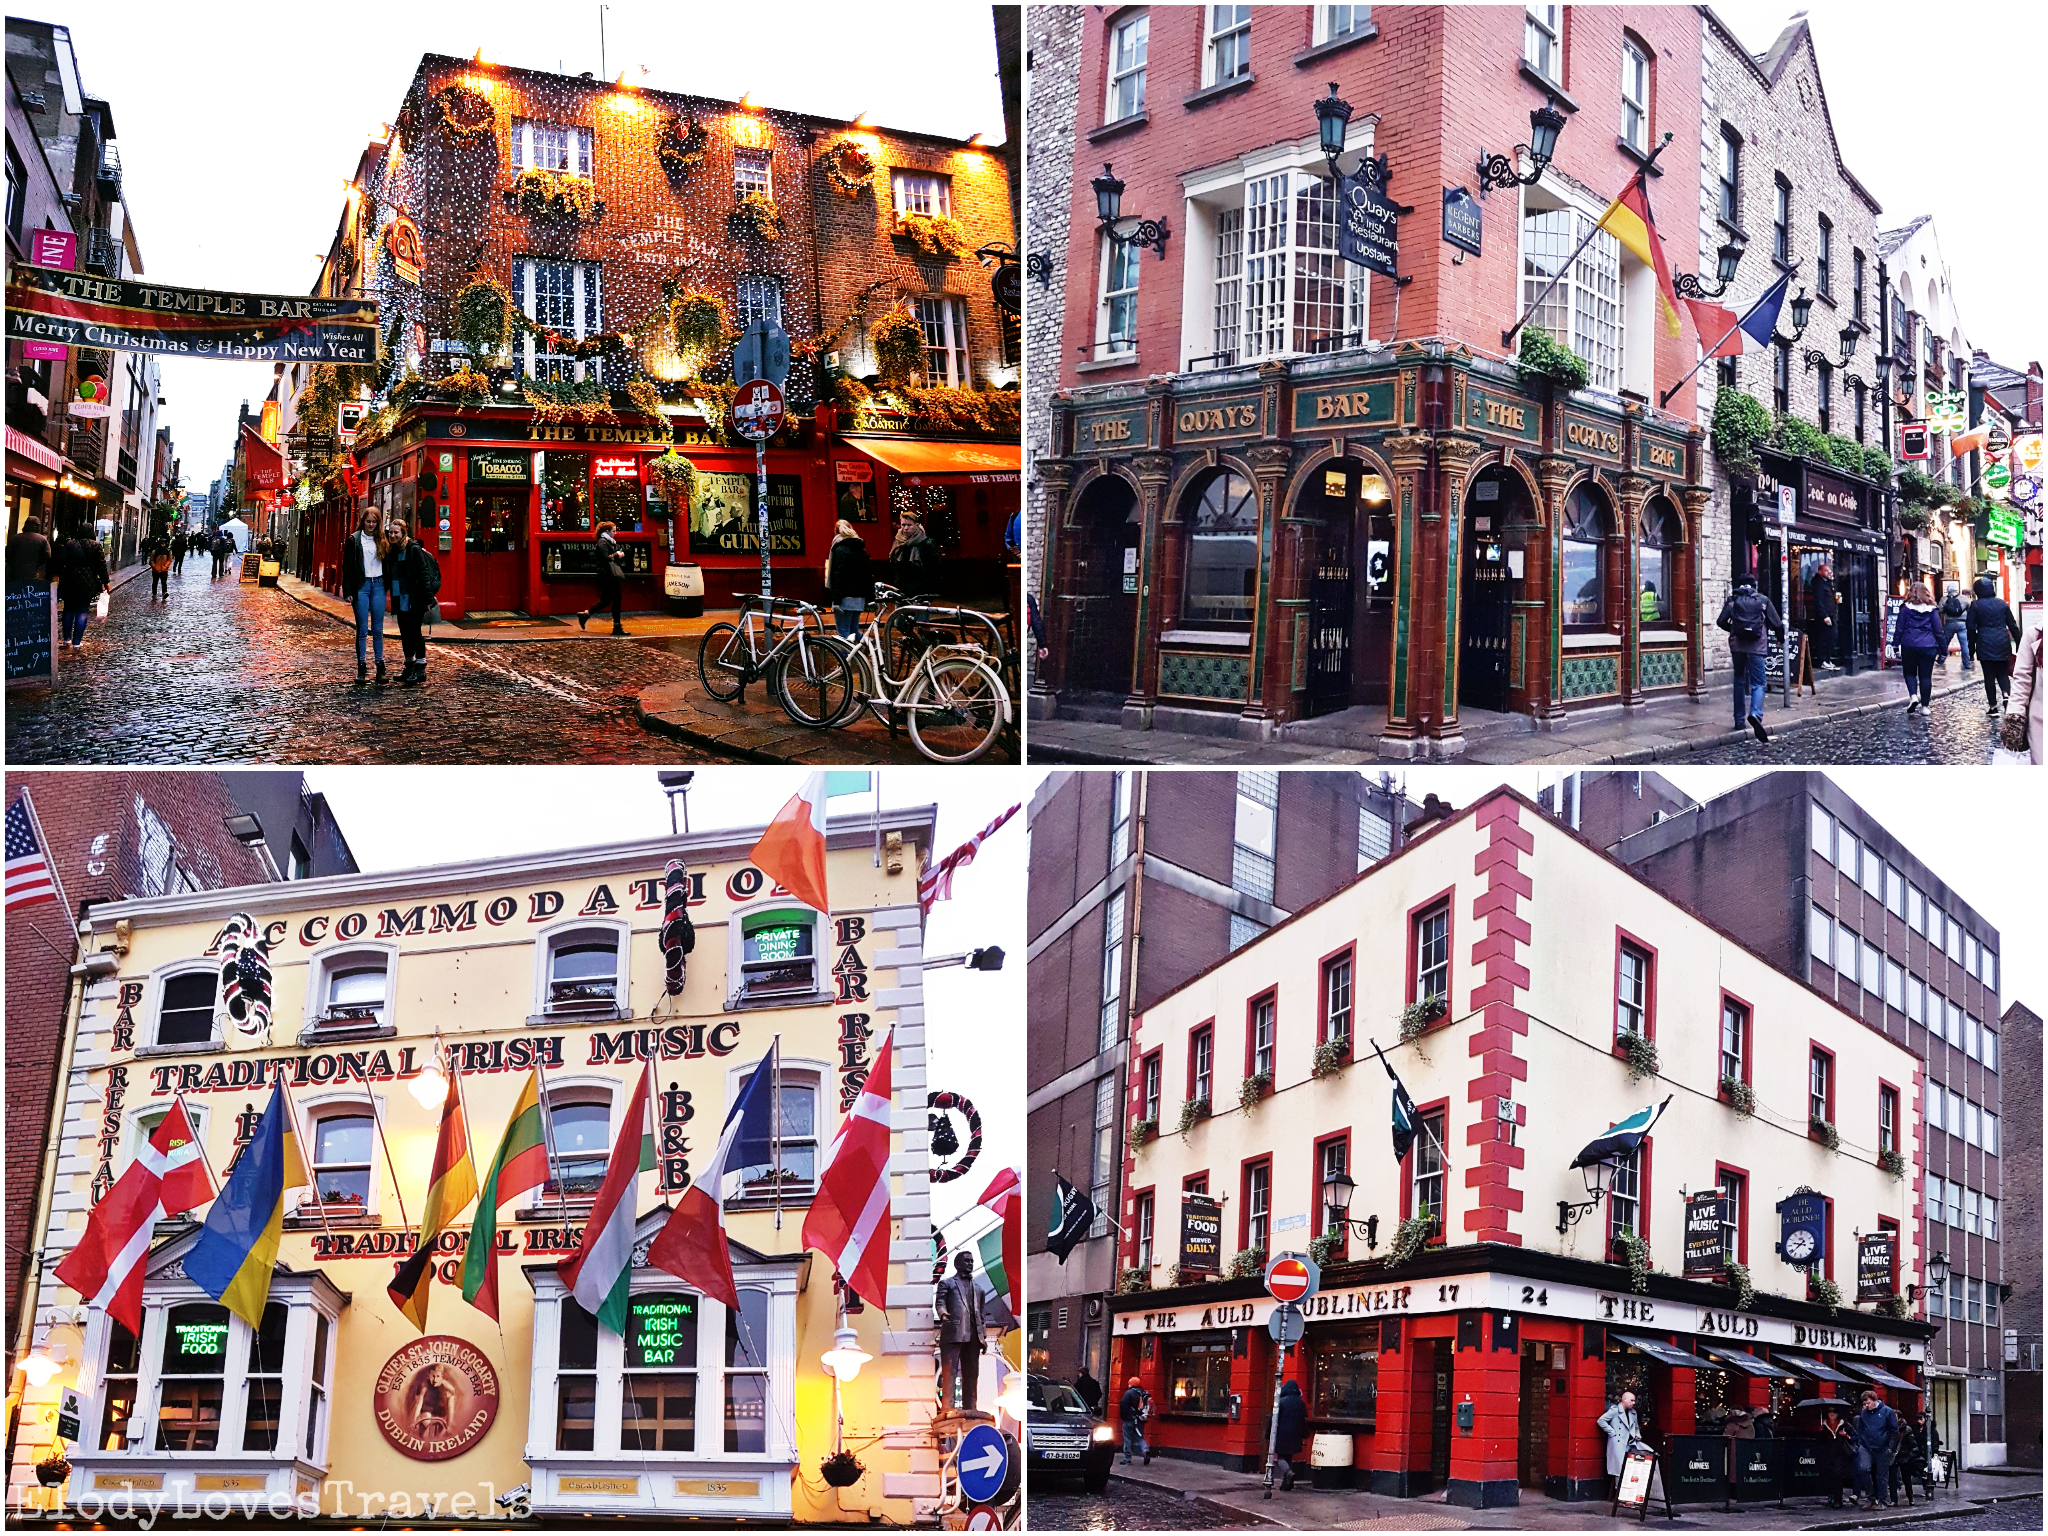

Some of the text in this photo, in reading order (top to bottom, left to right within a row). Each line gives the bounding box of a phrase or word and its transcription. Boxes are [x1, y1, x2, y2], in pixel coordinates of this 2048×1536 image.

[1447, 205, 1481, 229] REGENT
[1366, 218, 1386, 235] Irish
[1448, 219, 1480, 241] BARBERS
[1351, 222, 1399, 253] Restaurant
[1356, 240, 1392, 266] Upstairs
[63, 276, 312, 319] THE TEMPLE BAR
[12, 313, 366, 360] Merry Christmas & Happy New Year
[322, 332, 364, 342] Wishes All
[1316, 392, 1371, 420] BAR
[1485, 399, 1526, 432] THE
[451, 425, 463, 434] 48
[1091, 419, 1132, 443] THE
[526, 426, 731, 447] THE TEMPLE BAR
[1649, 444, 1677, 469] BAR
[252, 471, 281, 480] TEMPLE
[478, 461, 523, 477] TOBACCO
[708, 477, 748, 486] TEMPLE
[970, 475, 990, 483] THE
[721, 485, 740, 494] BAR
[777, 485, 794, 496] THE
[785, 507, 795, 518] OF
[720, 533, 801, 550] GUINESS
[754, 930, 801, 943] PRIVATE
[758, 940, 797, 952] DINING
[760, 950, 795, 961] ROOM
[150, 1021, 742, 1097] TRADITIONAL IRISH MUSIC
[1185, 1213, 1220, 1222] TRADITIONAL
[1693, 1205, 1716, 1221] LIVE
[1187, 1219, 1218, 1234] FOOD
[1688, 1219, 1720, 1232] MUSIC
[1186, 1243, 1216, 1253] DAILY
[1688, 1238, 1718, 1249] EVERY DAY
[1686, 1245, 1721, 1259] TILL LATE
[1864, 1244, 1887, 1257] LIVE
[1861, 1255, 1890, 1265] MUSIC
[1859, 1276, 1891, 1287] TILL LATE
[632, 1304, 693, 1316] TRADITIONAL
[1122, 1284, 1461, 1330] 7 THE AULD UBLINER 17
[644, 1317, 678, 1331] IRISH
[1521, 1285, 1549, 1307] 24
[1598, 1294, 1656, 1323] THE
[1699, 1309, 1760, 1339] AULD
[1792, 1322, 1878, 1354] DUBLINER
[175, 1324, 229, 1334] TRADITIONAL
[183, 1332, 218, 1344] IRISH
[637, 1333, 683, 1347] MUSIC
[181, 1343, 218, 1354] FOOD
[644, 1349, 675, 1364] BAR
[377, 1341, 497, 1396] OLIVER ST JOHN GOGARTY
[392, 1354, 483, 1397] EST 1835 TEMPLE BAR
[378, 1408, 489, 1453] DUBLIN IRELAND
[1688, 1460, 1710, 1470] GUINNESS
[1748, 1462, 1767, 1471] GUINNESS
[1798, 1456, 1816, 1465] GUINNESS
[706, 1481, 728, 1494] 1835
